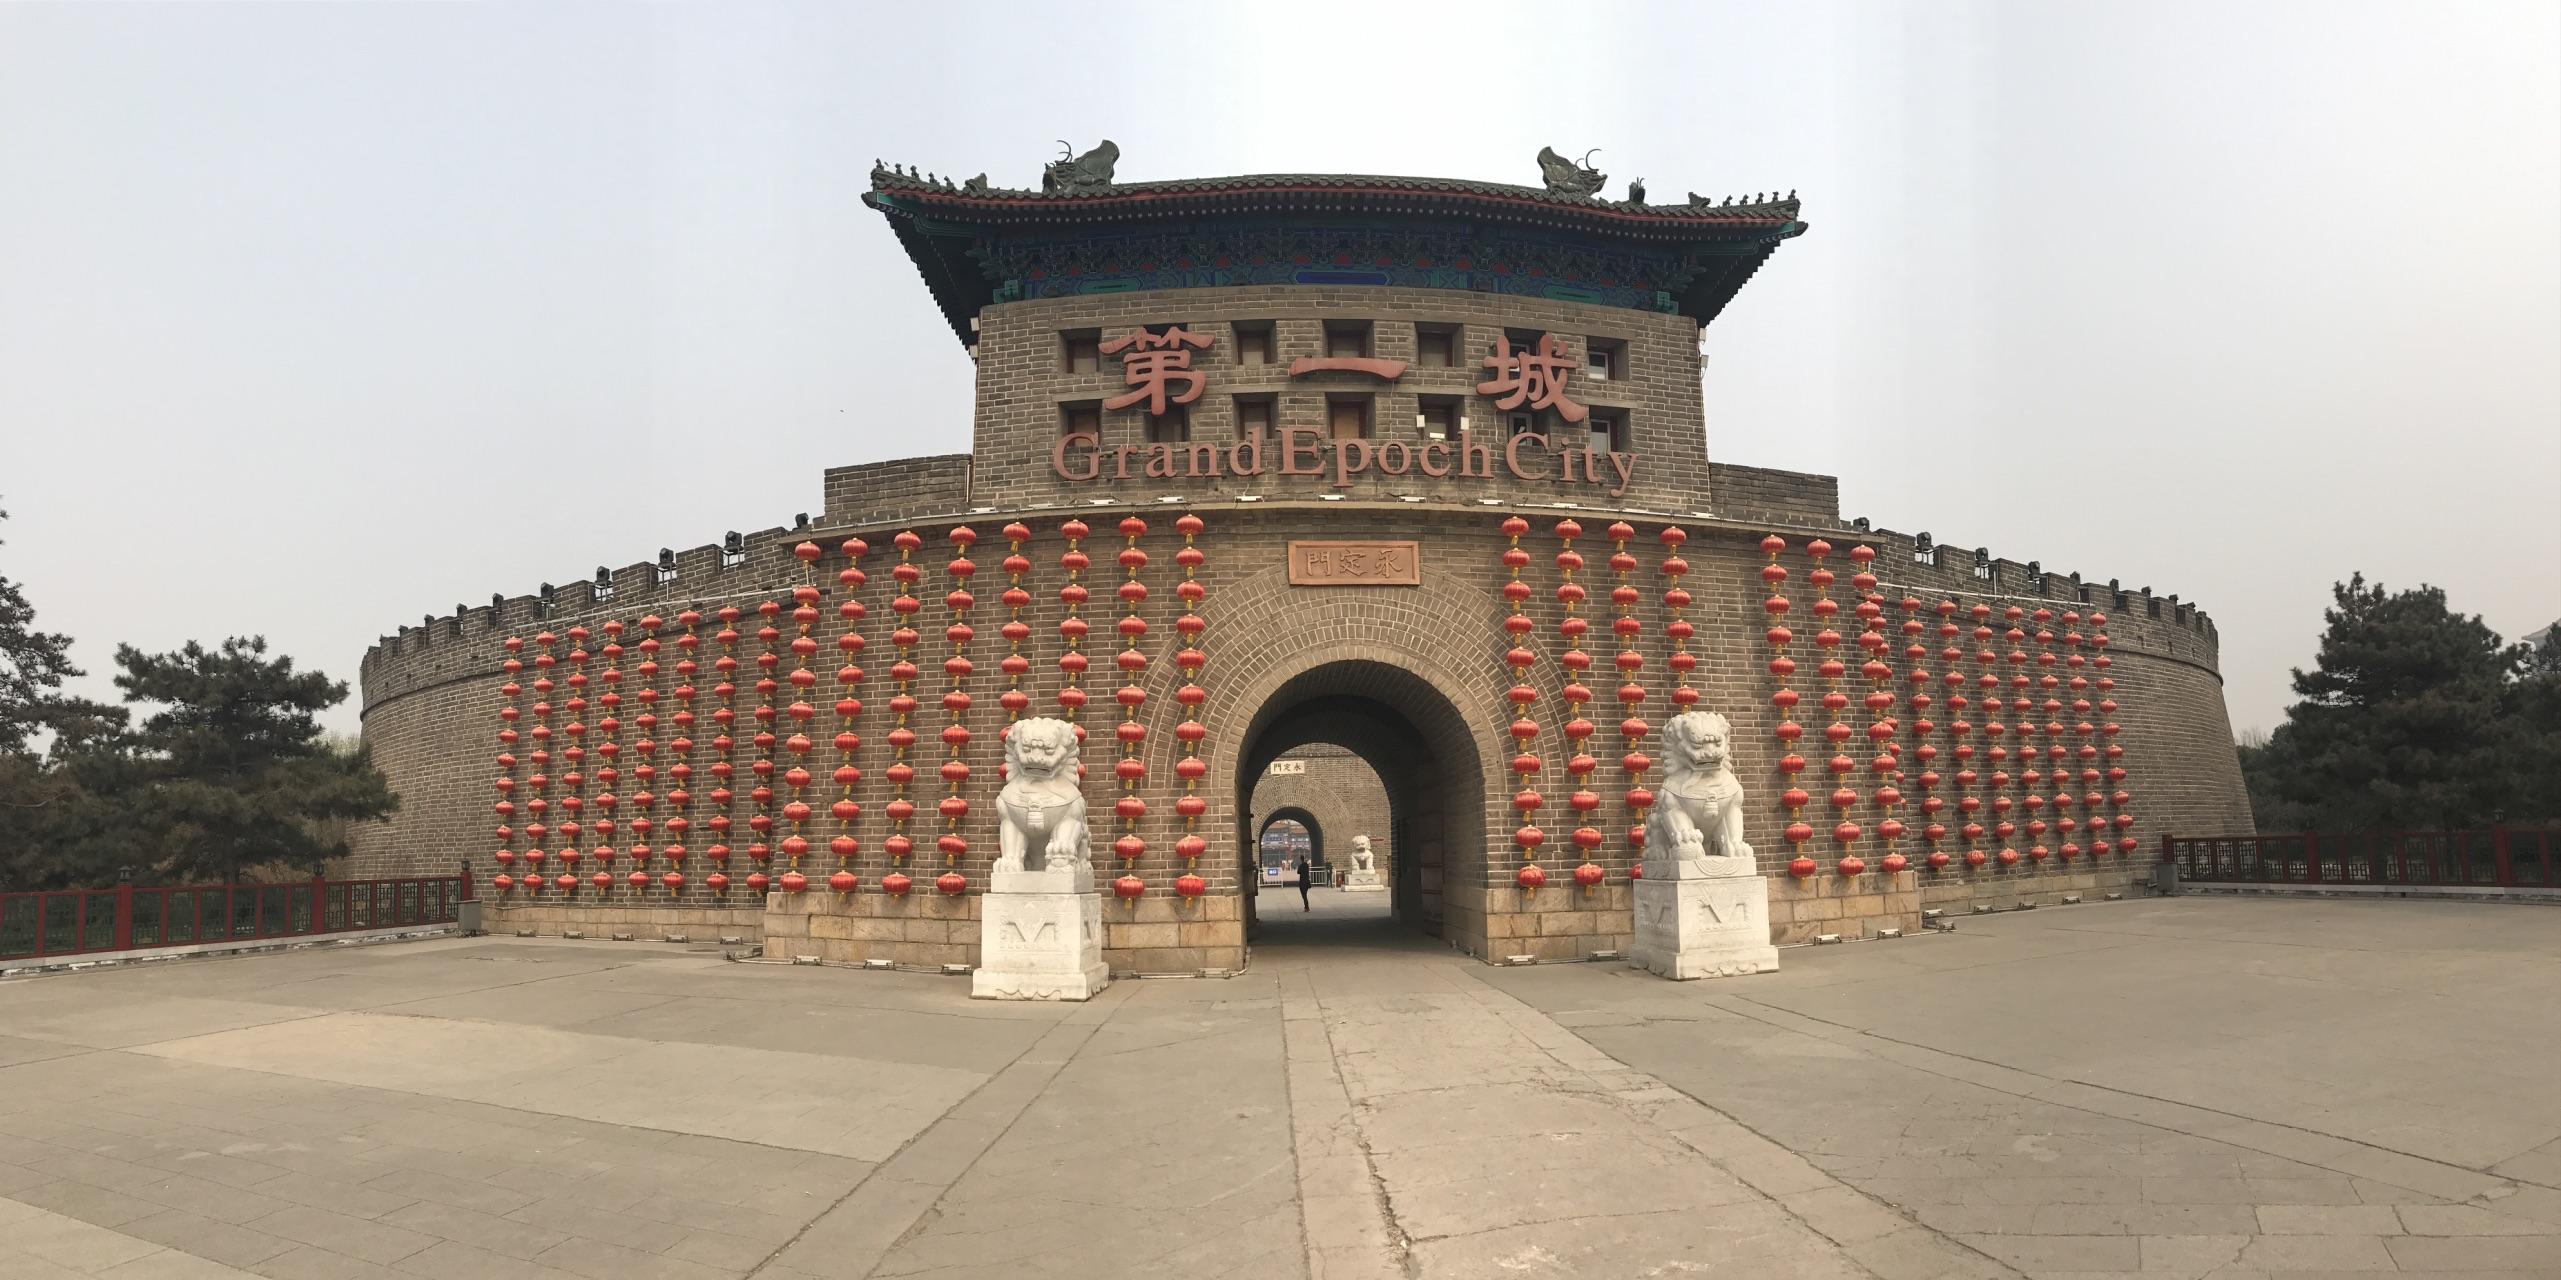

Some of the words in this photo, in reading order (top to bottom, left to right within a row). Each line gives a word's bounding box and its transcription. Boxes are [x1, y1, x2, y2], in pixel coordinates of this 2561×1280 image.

[1098, 325, 1589, 423] 第一城
[1053, 426, 1265, 482] Grand
[1276, 426, 1494, 488] Epoch
[1505, 432, 1639, 497] City
